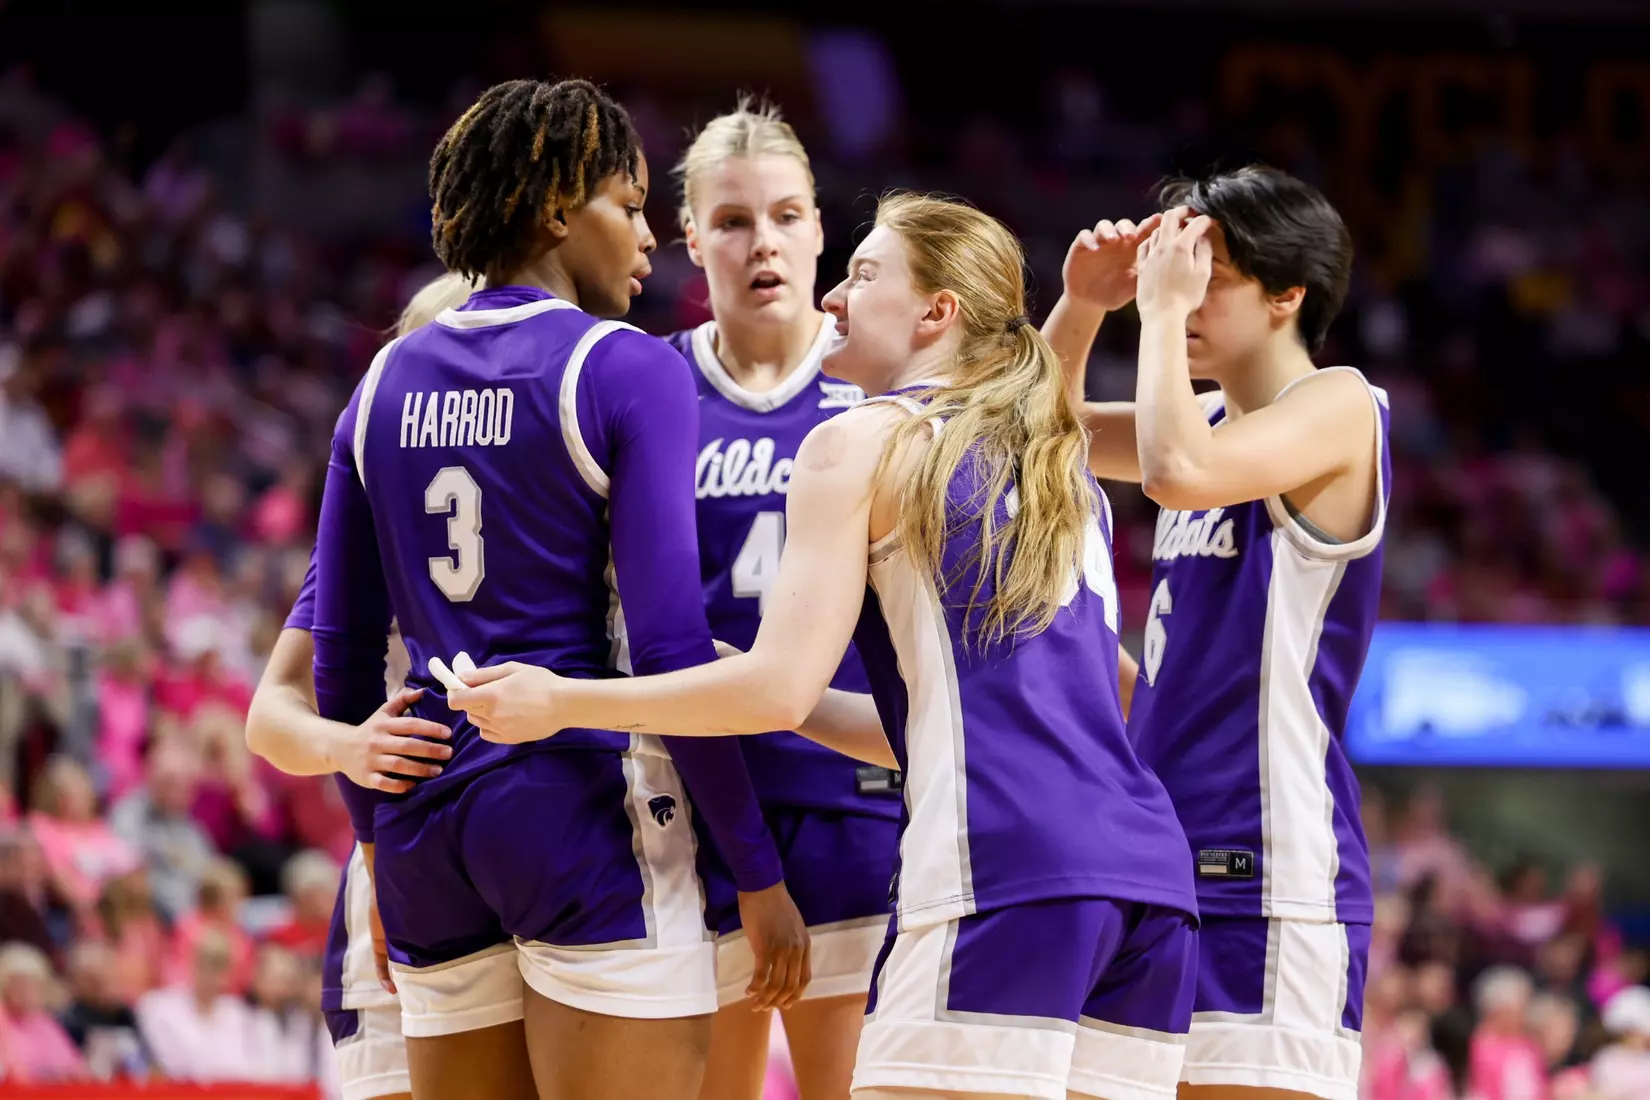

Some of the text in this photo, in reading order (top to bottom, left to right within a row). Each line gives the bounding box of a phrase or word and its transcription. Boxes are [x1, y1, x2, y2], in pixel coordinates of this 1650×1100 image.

[400, 388, 514, 447] HARROD
[695, 437, 795, 499] ildc
[424, 465, 485, 602] 3
[731, 511, 785, 621] 4
[1143, 577, 1172, 687] 6
[1235, 857, 1246, 870] M
